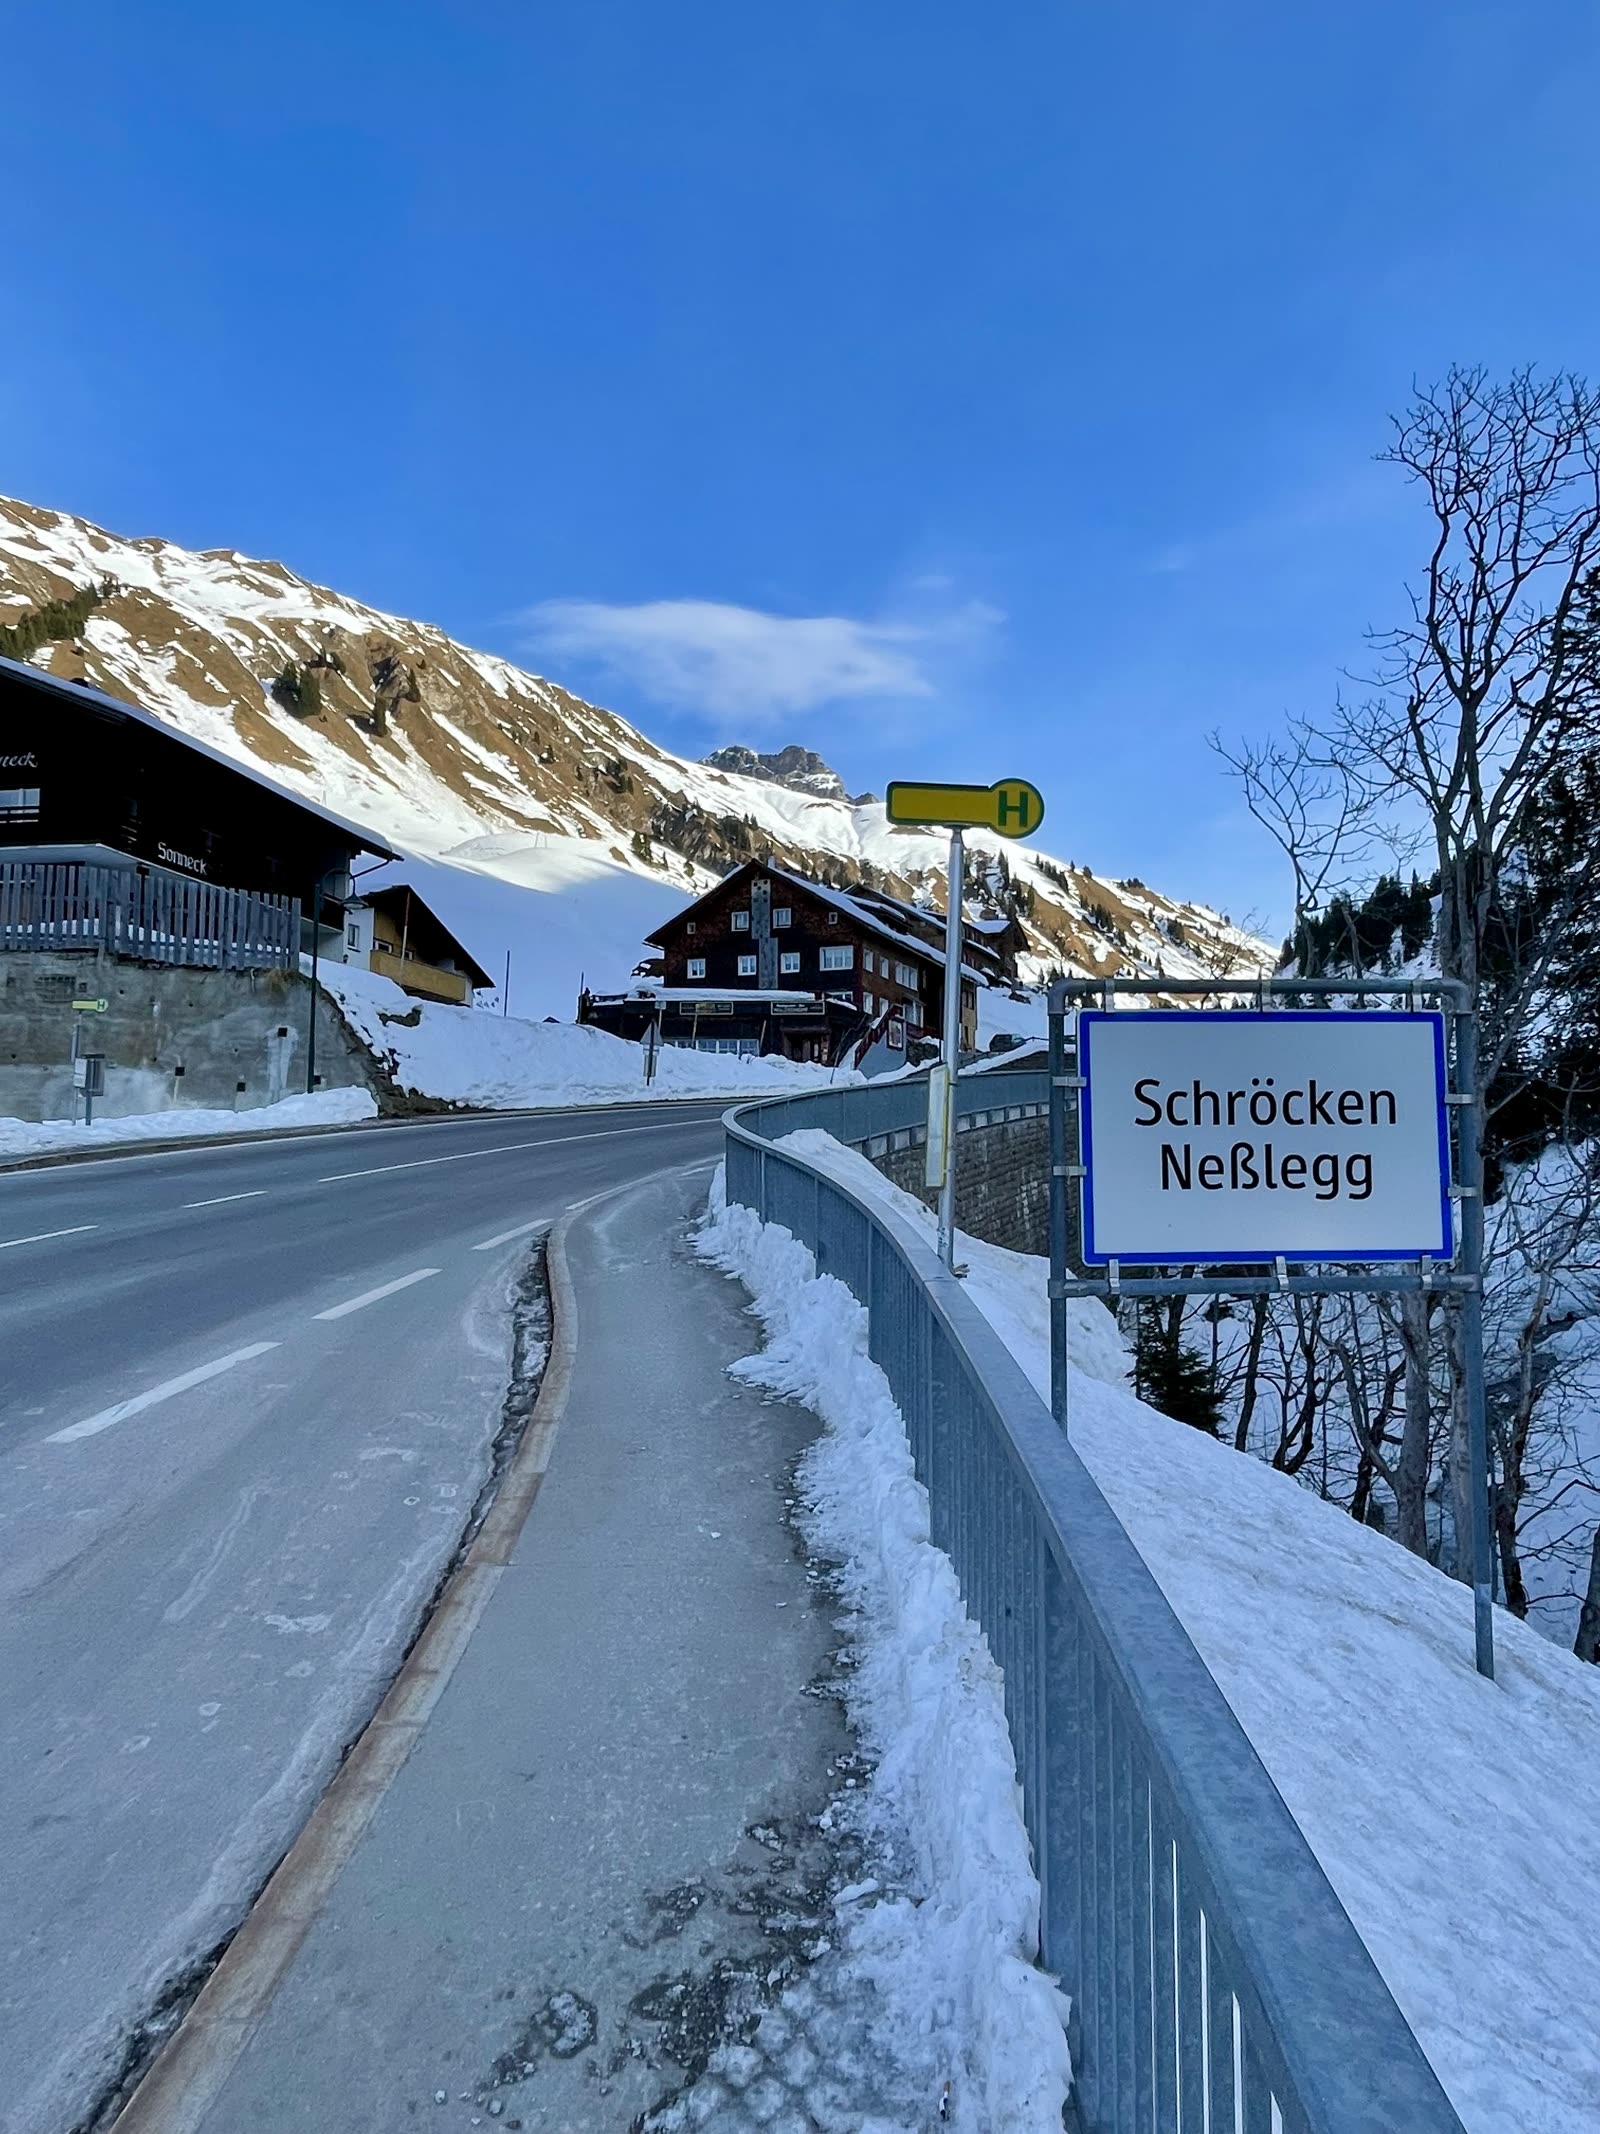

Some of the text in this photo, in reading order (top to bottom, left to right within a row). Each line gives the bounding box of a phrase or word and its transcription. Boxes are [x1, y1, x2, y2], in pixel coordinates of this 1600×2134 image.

[998, 790, 1029, 828] H
[157, 841, 207, 876] Sonneck
[97, 1000, 106, 1011] H
[1133, 1078, 1397, 1127] Schröcken
[1160, 1142, 1373, 1200] Neßlegg
